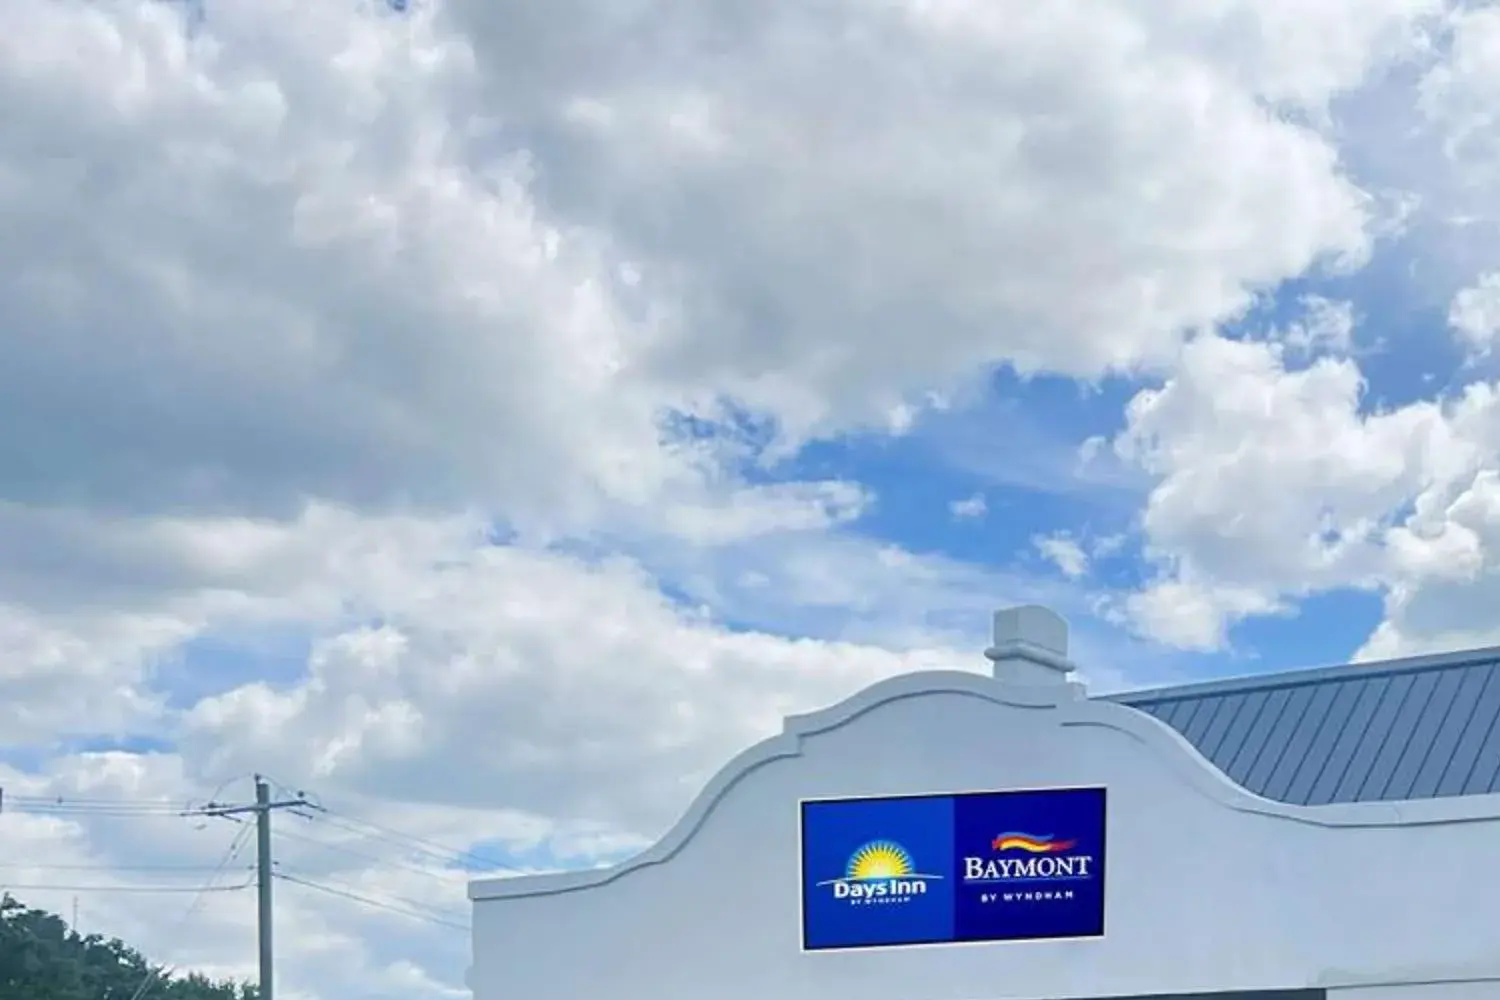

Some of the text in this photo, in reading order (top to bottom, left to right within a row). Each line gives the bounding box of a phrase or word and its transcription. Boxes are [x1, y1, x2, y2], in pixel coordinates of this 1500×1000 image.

[964, 856, 1092, 879] BAYMONT
[834, 880, 926, 898] Days Inn
[981, 893, 997, 903] BY
